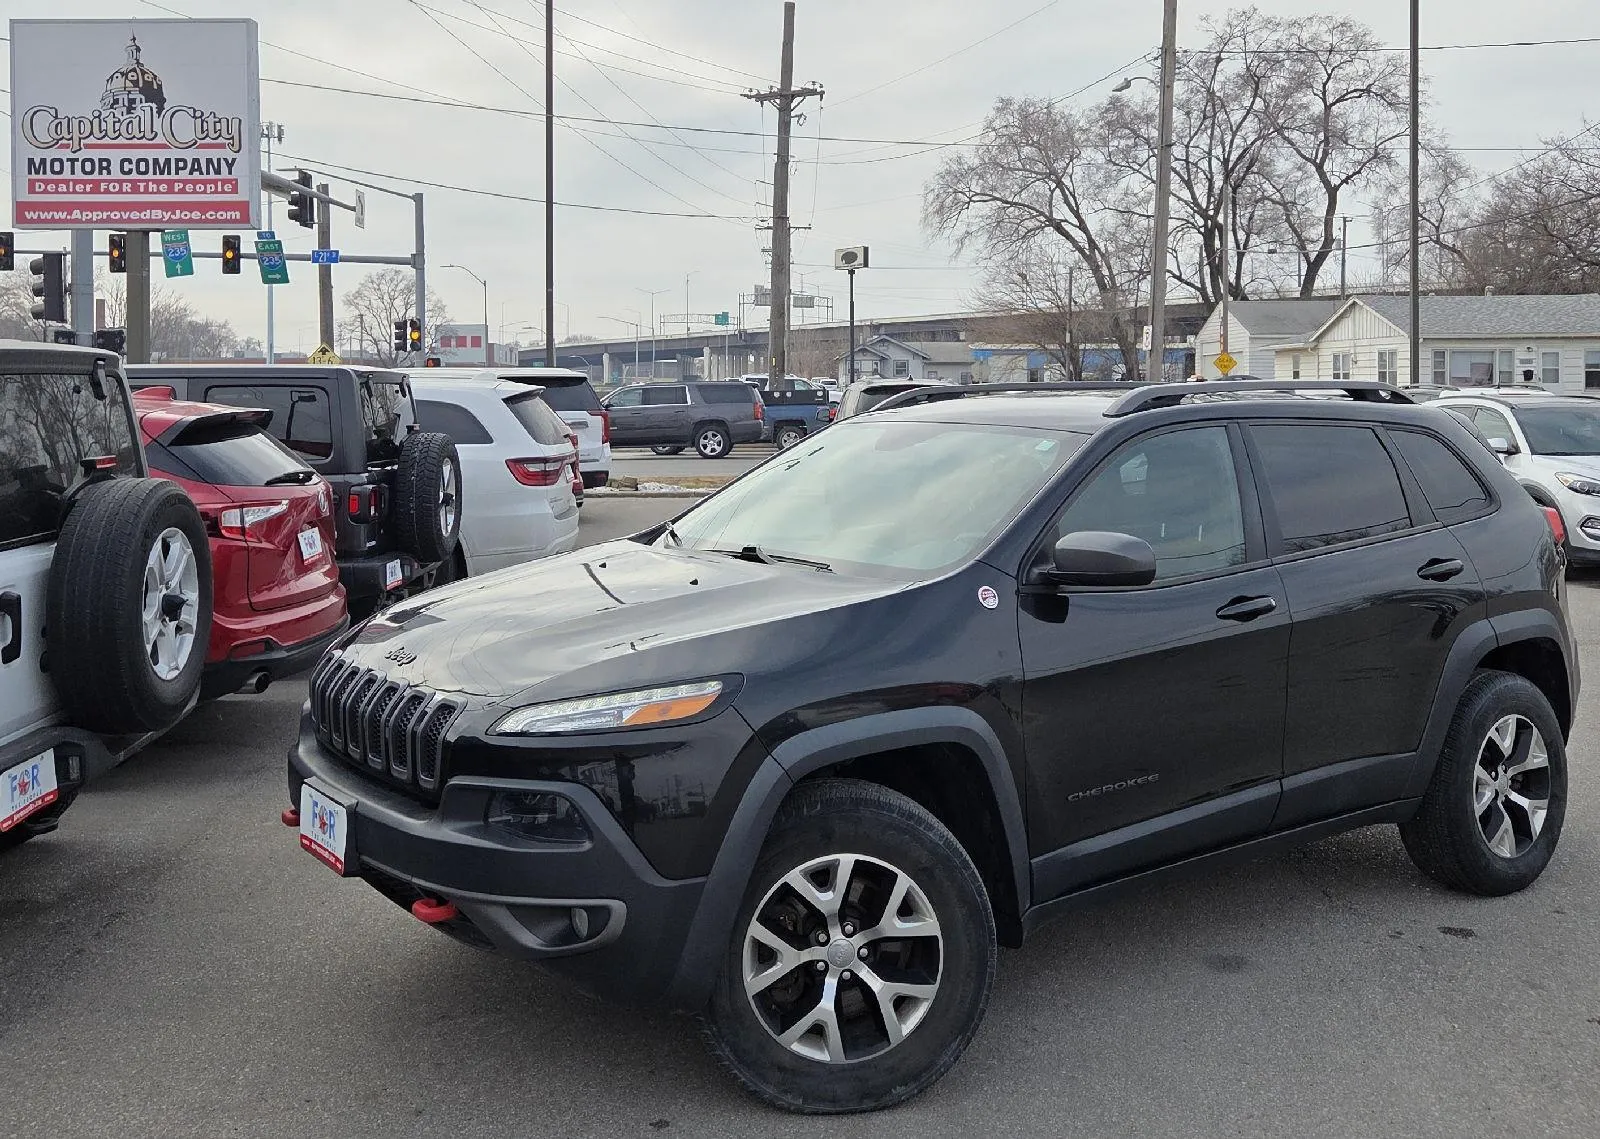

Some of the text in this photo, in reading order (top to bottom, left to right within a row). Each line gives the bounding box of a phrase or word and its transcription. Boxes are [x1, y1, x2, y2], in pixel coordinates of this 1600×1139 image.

[21, 104, 241, 153] Capital City
[27, 157, 237, 176] MOTOR COMPANY
[35, 182, 233, 194] Dealer FOR The People
[24, 209, 241, 221] www.ApprovedByJoe.com
[163, 233, 186, 242] WEST
[167, 247, 187, 257] 235
[258, 242, 279, 251] EAST
[262, 256, 281, 266] 235
[384, 646, 418, 667] Jeep
[1067, 773, 1160, 801] CHEROKEE
